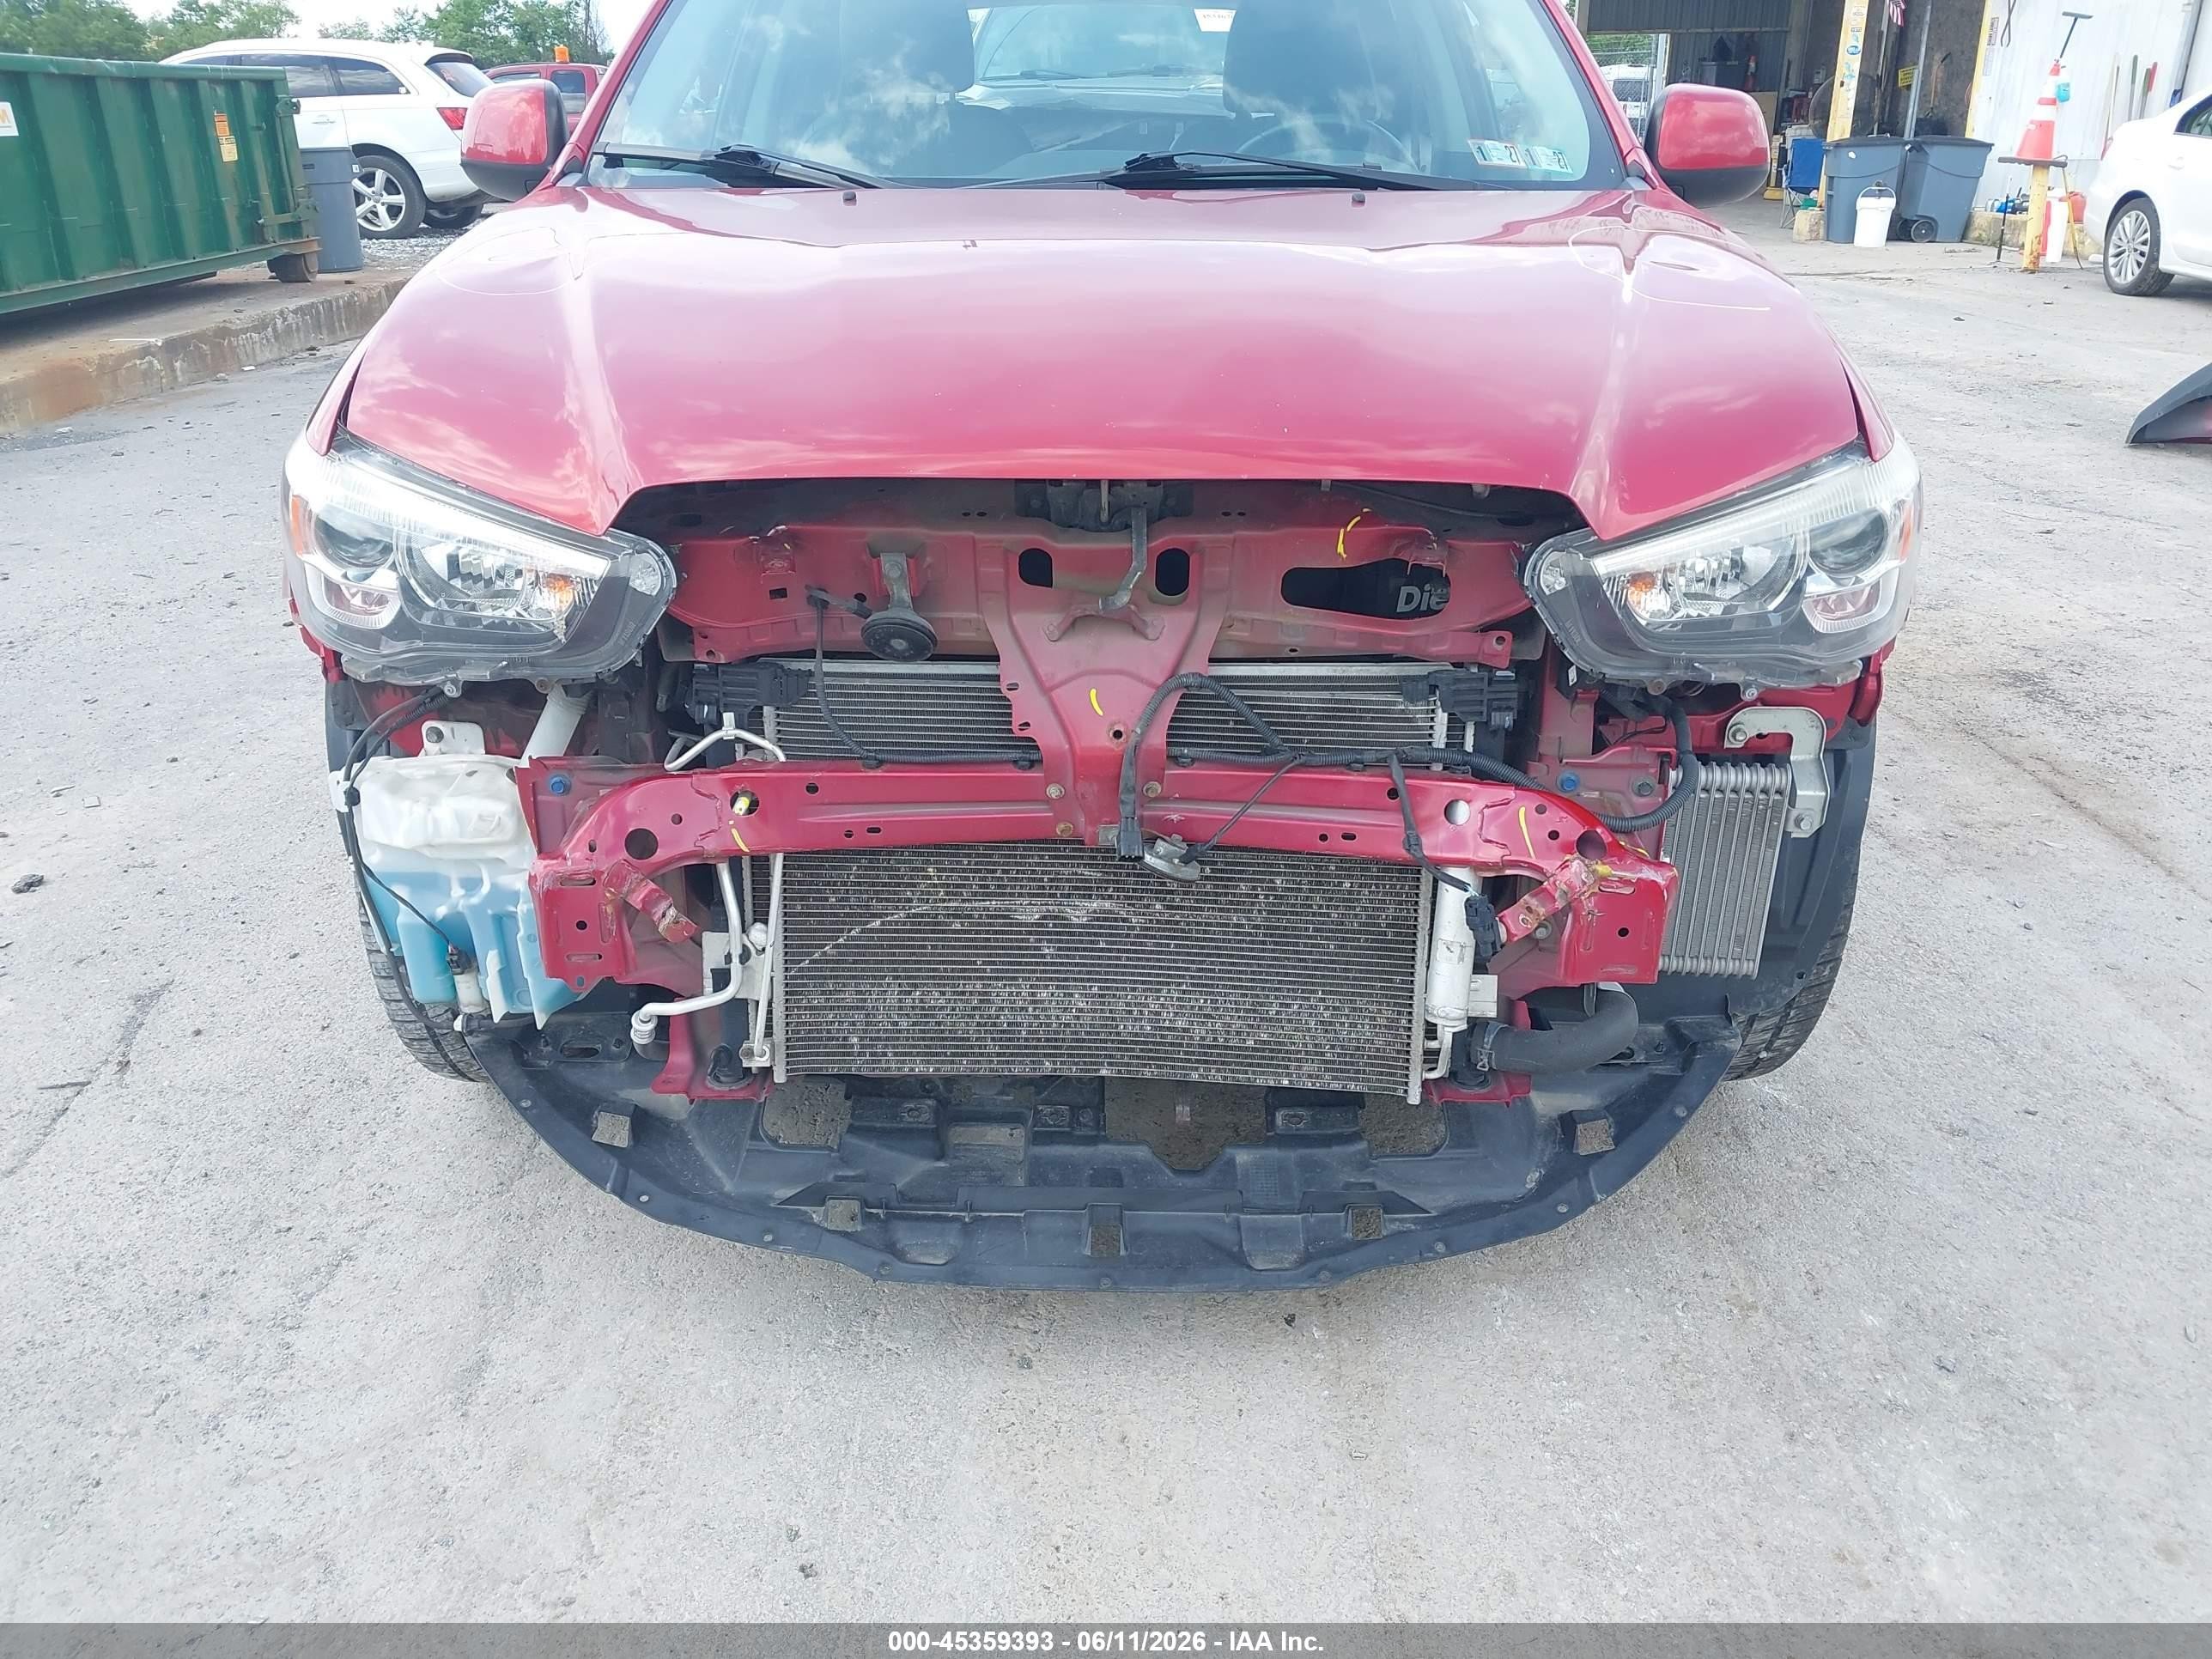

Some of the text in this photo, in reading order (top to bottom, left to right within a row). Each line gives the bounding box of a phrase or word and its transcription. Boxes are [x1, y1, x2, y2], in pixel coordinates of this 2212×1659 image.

[1476, 145, 1488, 161] 1
[1504, 145, 1521, 165] 27
[1553, 151, 1569, 169] 27
